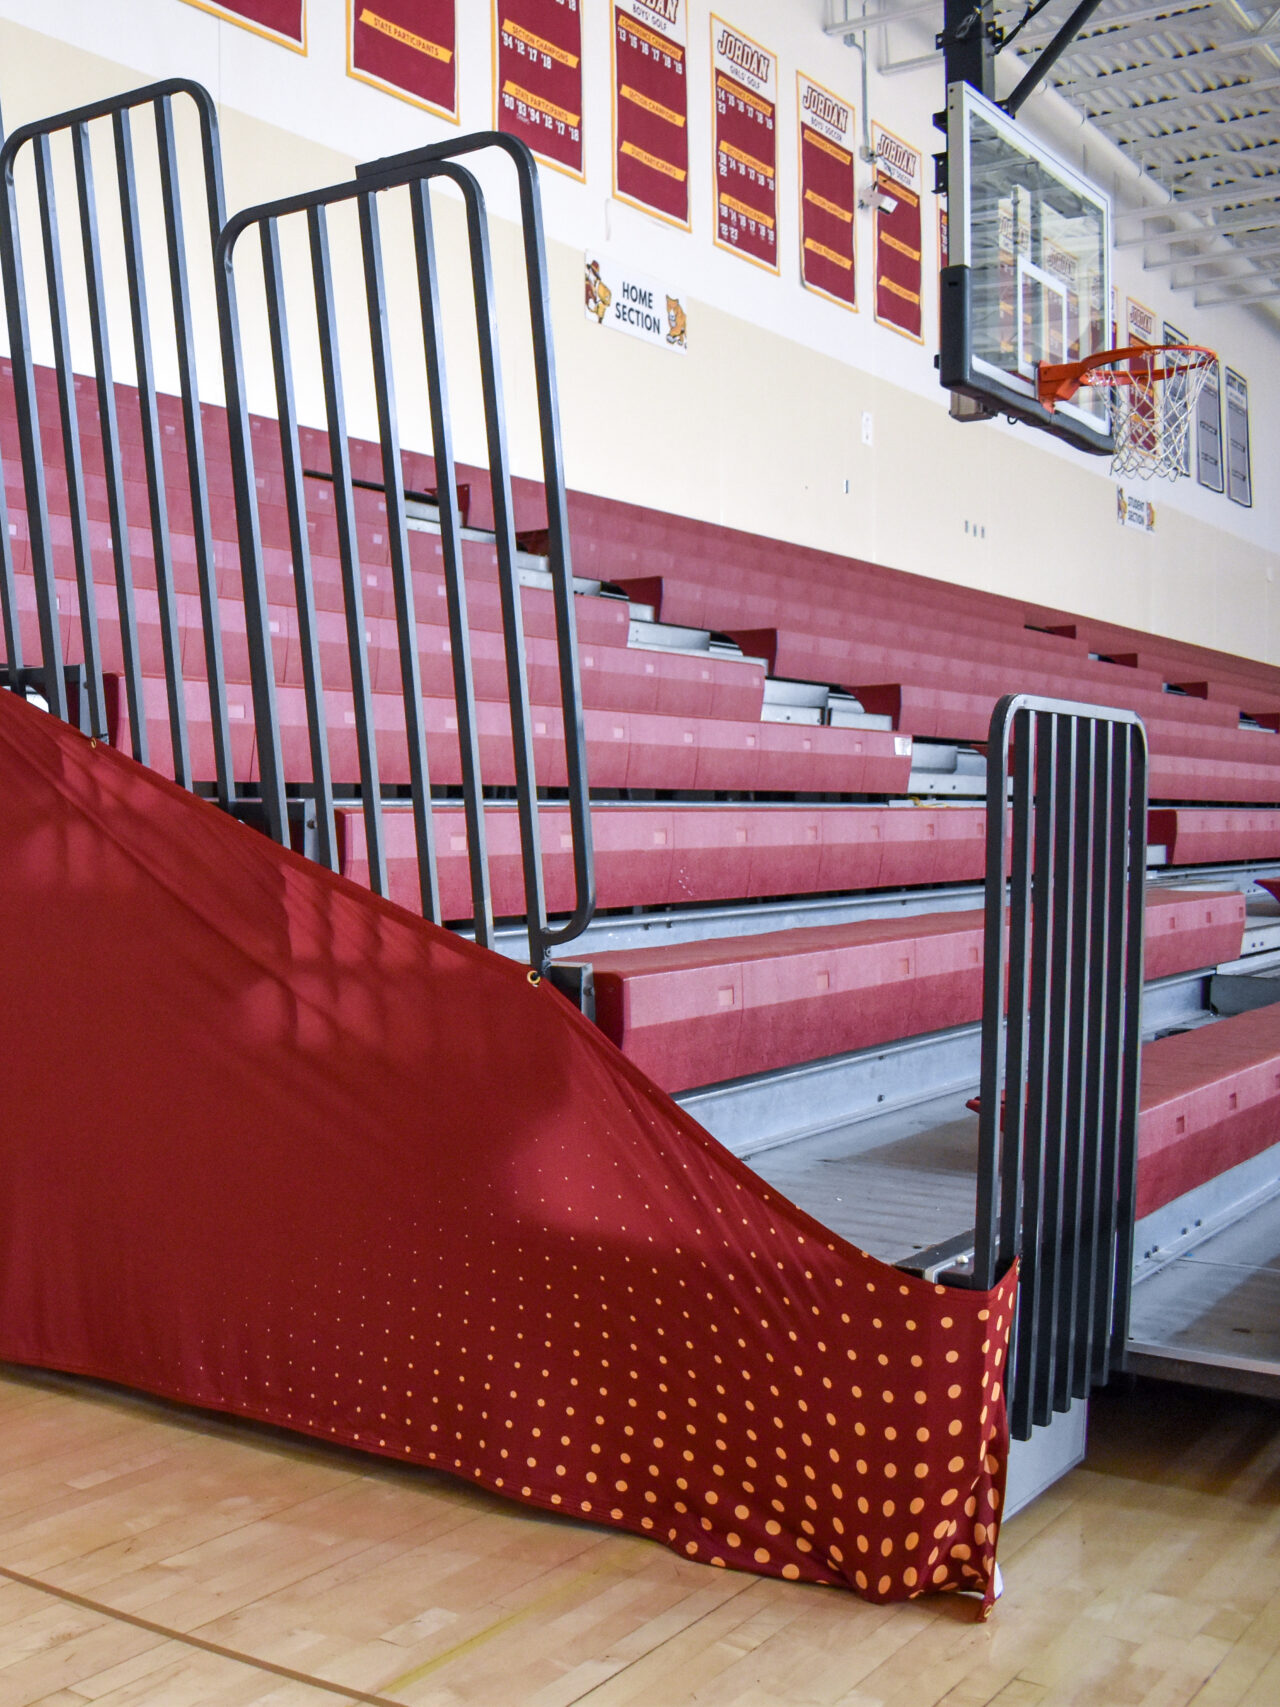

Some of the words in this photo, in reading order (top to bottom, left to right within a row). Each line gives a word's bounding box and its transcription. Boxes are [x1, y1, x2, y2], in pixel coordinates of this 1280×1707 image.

[374, 17, 392, 34] STATE
[393, 28, 439, 57] PARTICIPANTS
[515, 38, 526, 56] '12
[527, 46, 538, 62] '17
[717, 29, 770, 83] JORDAN
[542, 113, 553, 130] '12
[803, 85, 848, 134] JORDAN
[877, 133, 916, 178] JORDAN
[622, 281, 653, 309] HOME
[615, 302, 661, 334] SECTION
